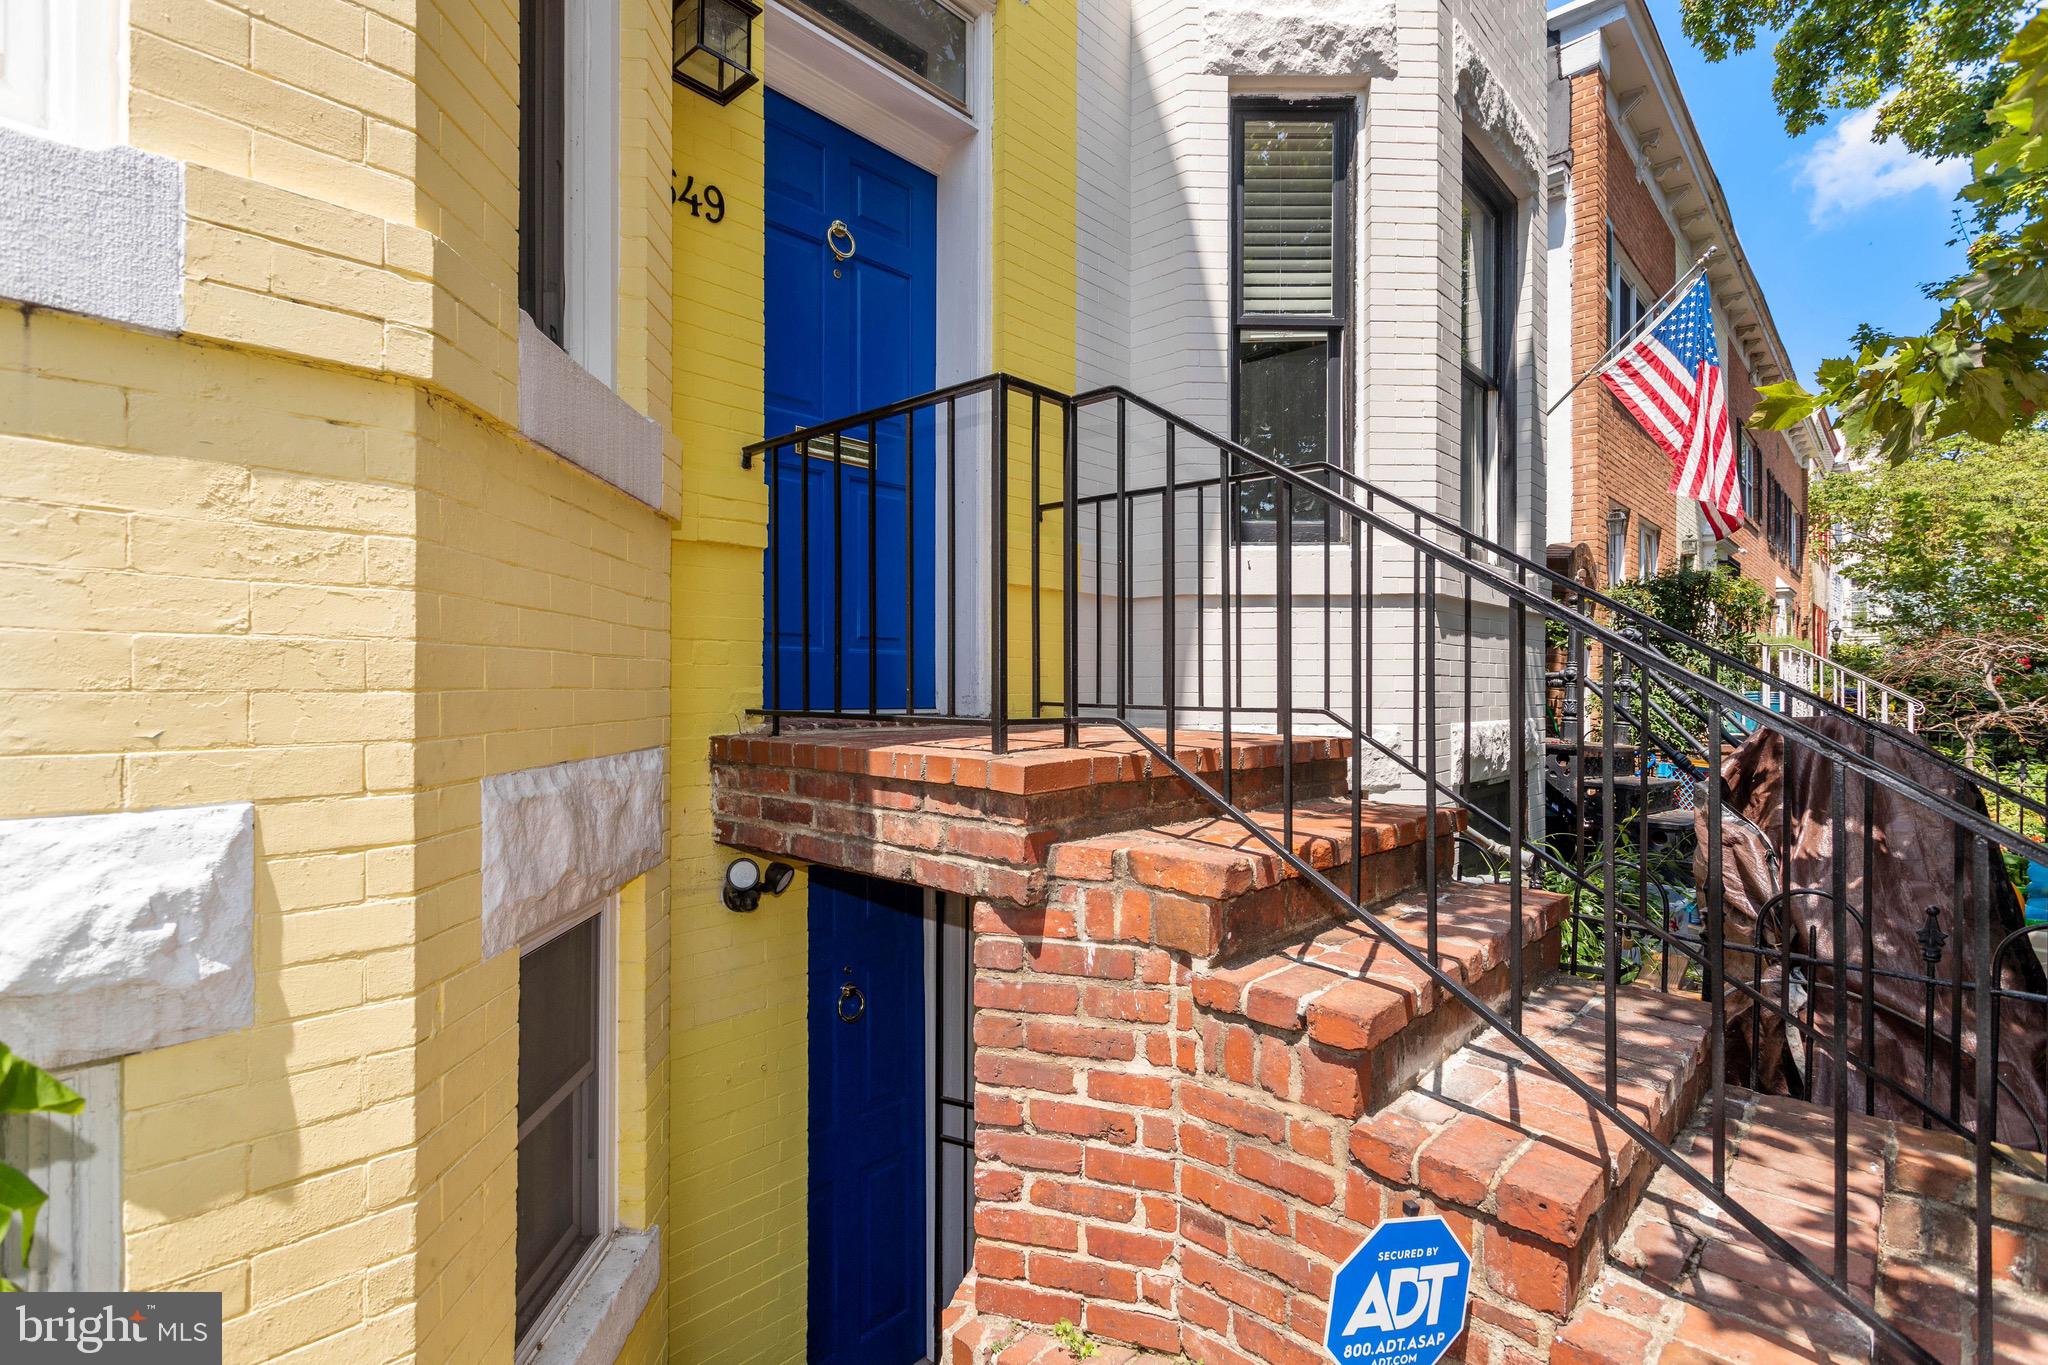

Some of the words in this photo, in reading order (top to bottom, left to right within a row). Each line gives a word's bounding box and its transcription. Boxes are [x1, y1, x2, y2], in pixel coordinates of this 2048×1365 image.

[671, 169, 725, 223] 49
[1378, 1249, 1424, 1261] SECURED
[1426, 1247, 1439, 1256] BY
[1341, 1262, 1460, 1337] ADT
[1343, 1332, 1446, 1359] 800.ADT.ASAP
